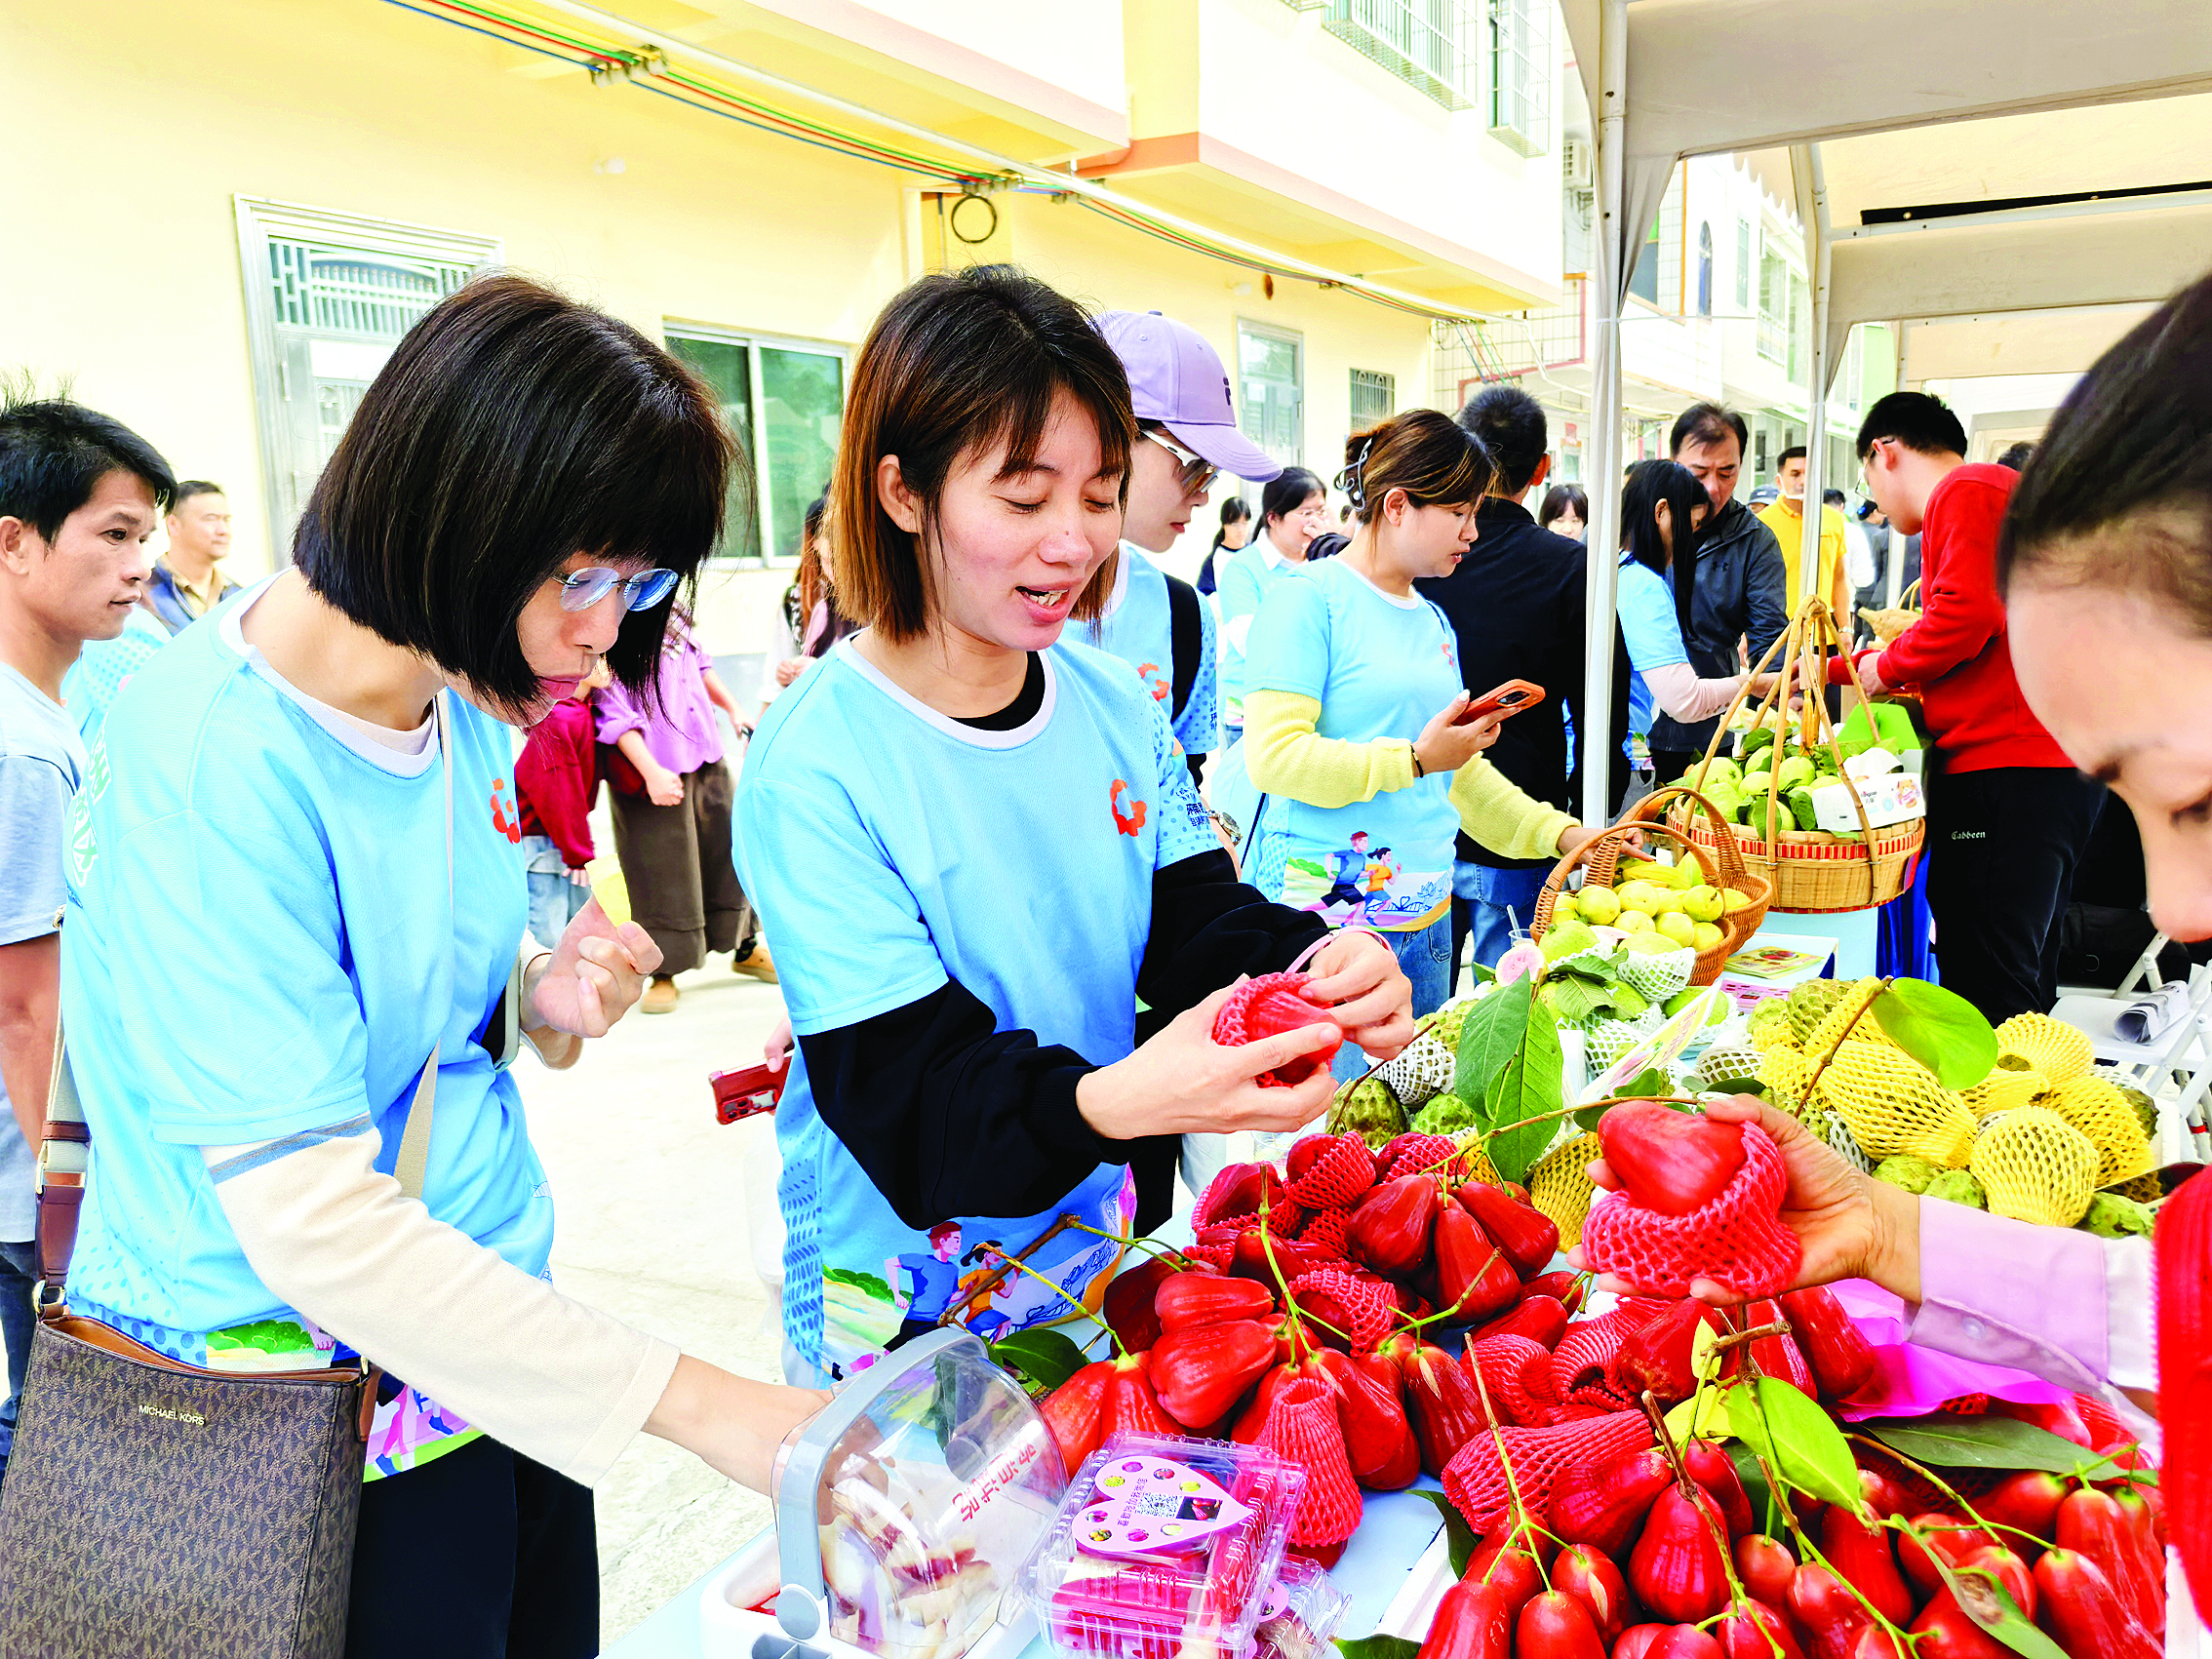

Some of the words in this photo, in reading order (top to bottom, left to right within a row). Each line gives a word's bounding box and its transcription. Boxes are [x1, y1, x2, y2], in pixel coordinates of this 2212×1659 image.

[1951, 830, 1986, 841] Cabbeen
[138, 1404, 178, 1419] MICHAEL
[179, 1412, 205, 1426] KORS
[951, 1438, 1038, 1522] 欢迎试吃
